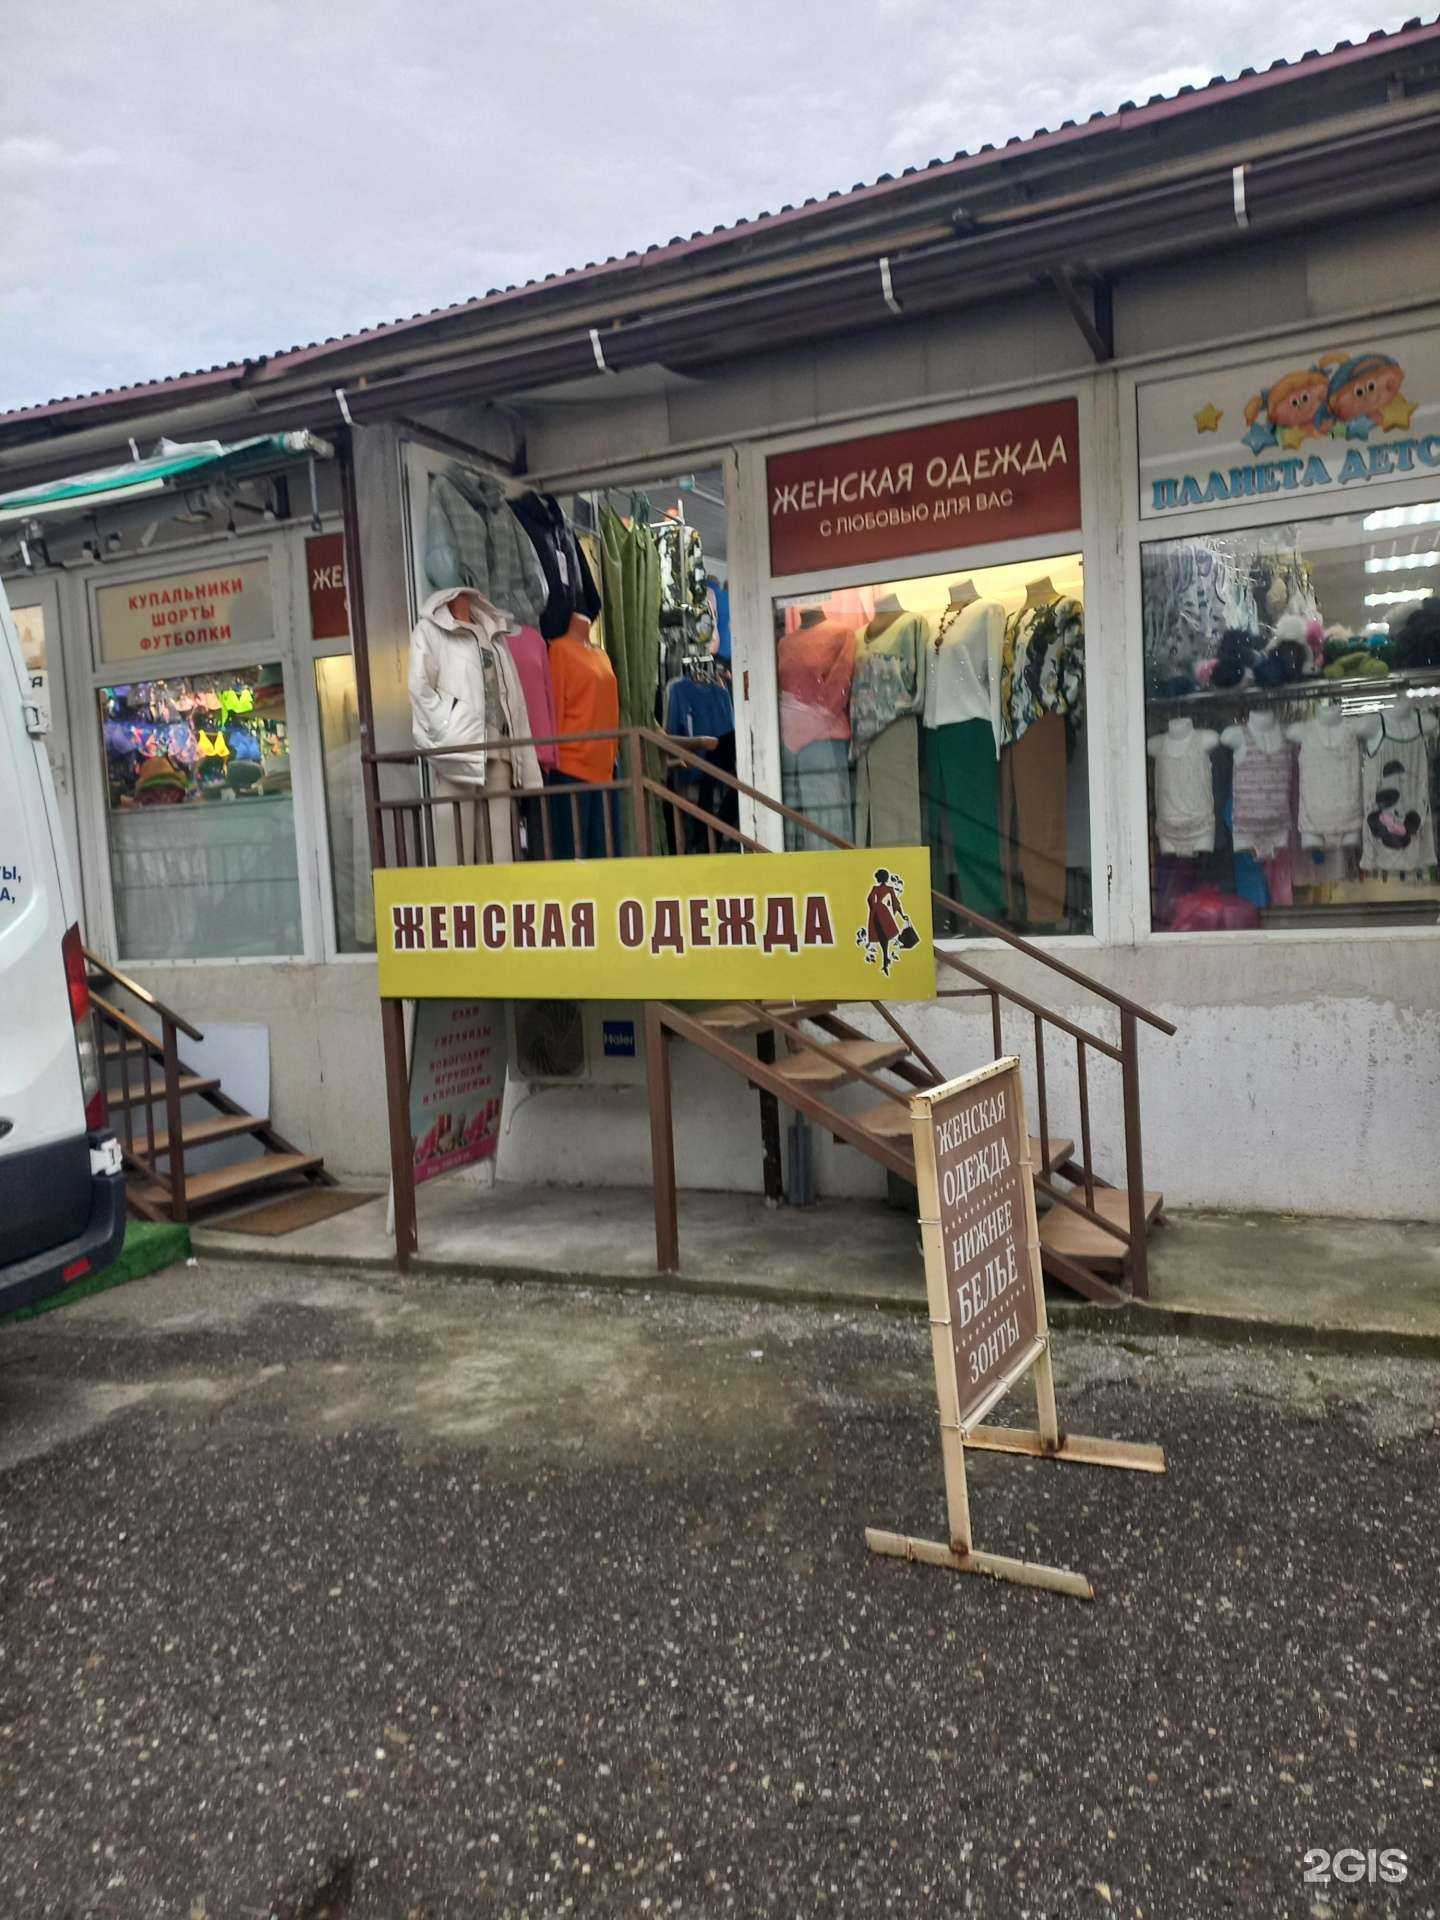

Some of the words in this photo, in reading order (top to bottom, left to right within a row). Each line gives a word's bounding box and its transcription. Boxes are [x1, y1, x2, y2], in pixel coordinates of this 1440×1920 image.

[773, 462, 914, 516] ЖЕНСКАЯ
[926, 434, 1068, 489] ОДЕЖДА
[1151, 454, 1332, 510] ПЛАНЕТА
[819, 520, 832, 537] С
[836, 502, 930, 535] ЛЮБОВЬЮ
[933, 495, 972, 521] ДЛЯ
[976, 488, 1014, 513] ВАС
[128, 577, 243, 610] КУПАЛЬНИКИ
[312, 565, 347, 593] ЖЕ
[140, 624, 232, 650] ФУТБОЛКИ
[152, 604, 215, 627] ШОРТЫ
[392, 901, 596, 950] ЖЕНСКАЯ
[618, 895, 836, 954] ОДЕЖДА
[603, 1033, 634, 1046] Haier
[936, 1090, 1007, 1157] ЖЕНСКАЯ
[942, 1136, 1011, 1208] ОДЕЖДА
[952, 1199, 1013, 1273] НИЖНЕЕ
[956, 1237, 1019, 1329] БЕЛЬЁ
[968, 1311, 1020, 1384] ЗОНТЫ
